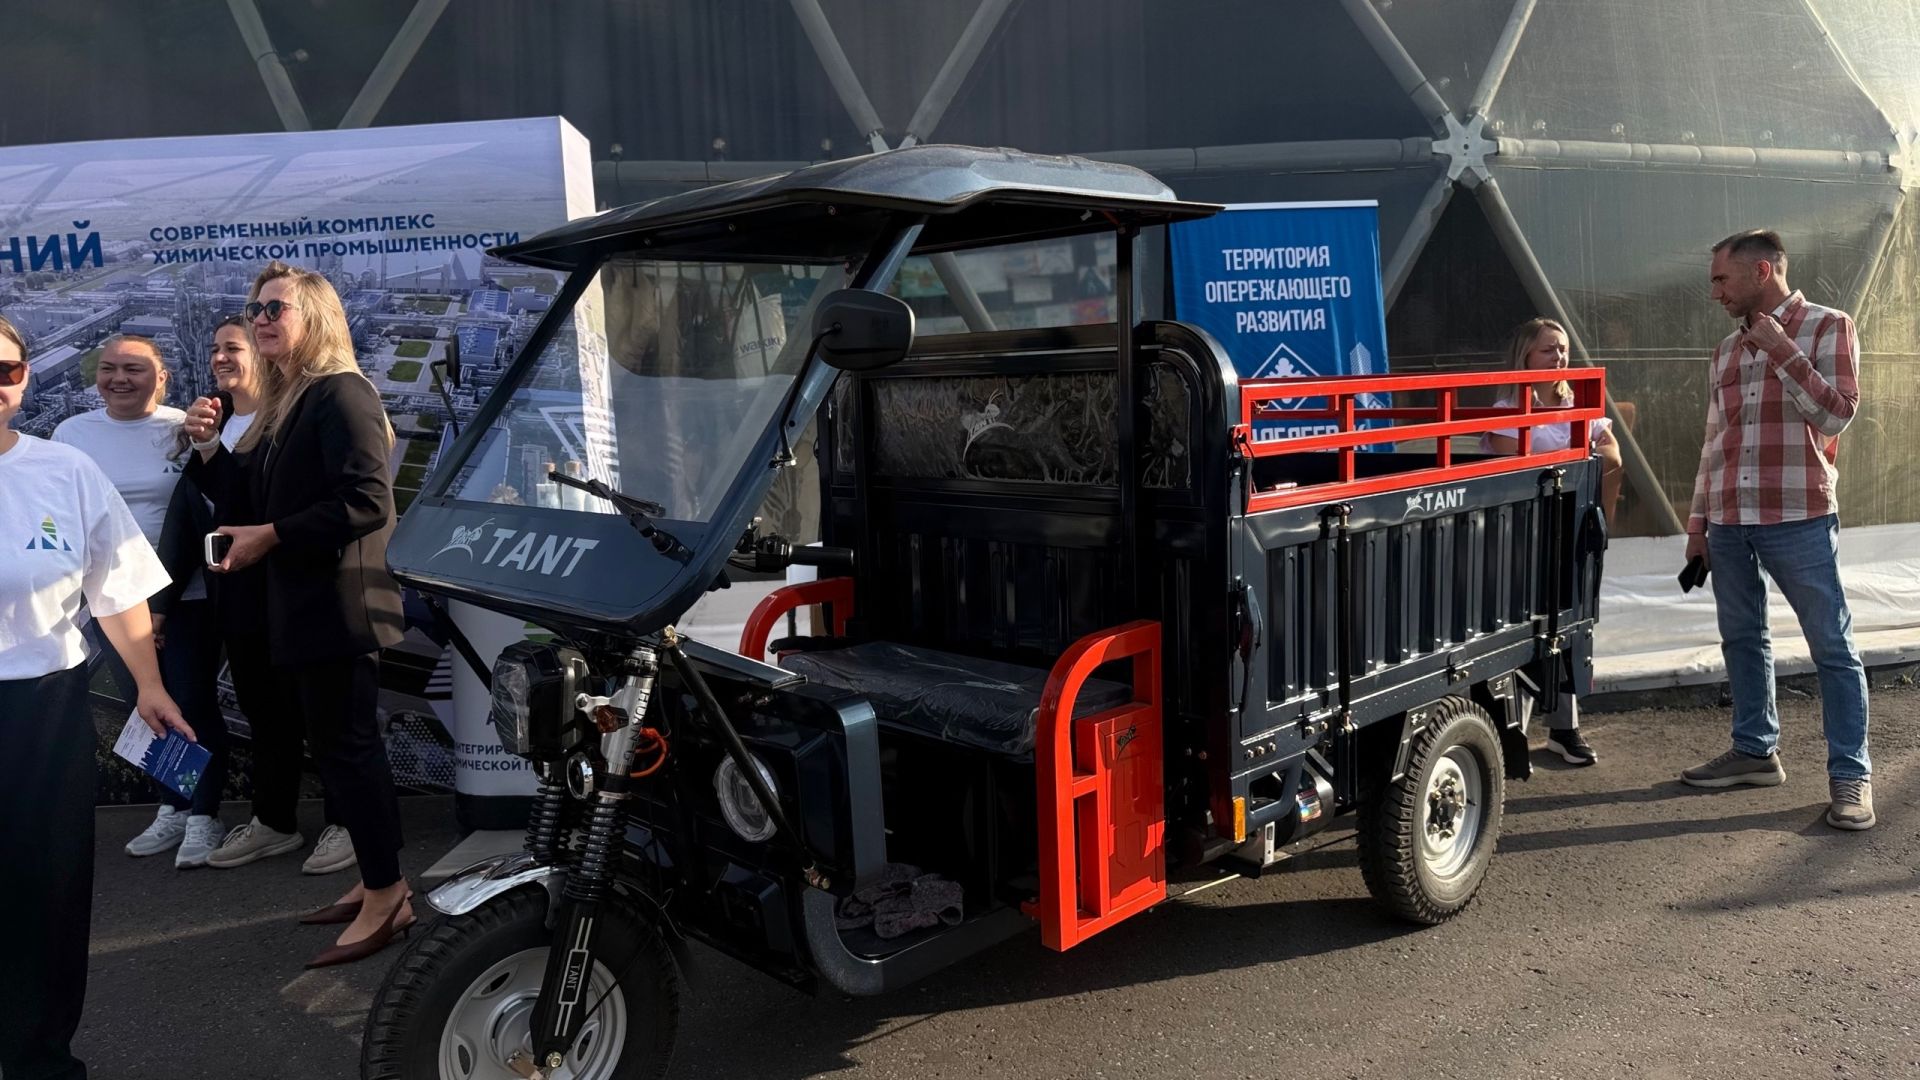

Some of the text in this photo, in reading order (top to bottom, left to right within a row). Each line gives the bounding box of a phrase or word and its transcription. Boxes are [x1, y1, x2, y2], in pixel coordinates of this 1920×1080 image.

[149, 213, 436, 243] СОВРЕМЕННЫЙ КОМПЛЕКС
[152, 231, 520, 265] ХИМИЧЕСКОЙ ПРОМЫШЛЕННОСТИ
[1222, 245, 1331, 273] ТЕРРИТОРИЯ
[1205, 276, 1351, 304] ОПЕРЕЖАЮЩЕГО
[1235, 308, 1326, 334] РАЗВИТИЯ
[1424, 488, 1466, 511] TANT
[481, 528, 600, 578] TANT
[566, 964, 581, 989] TANT
